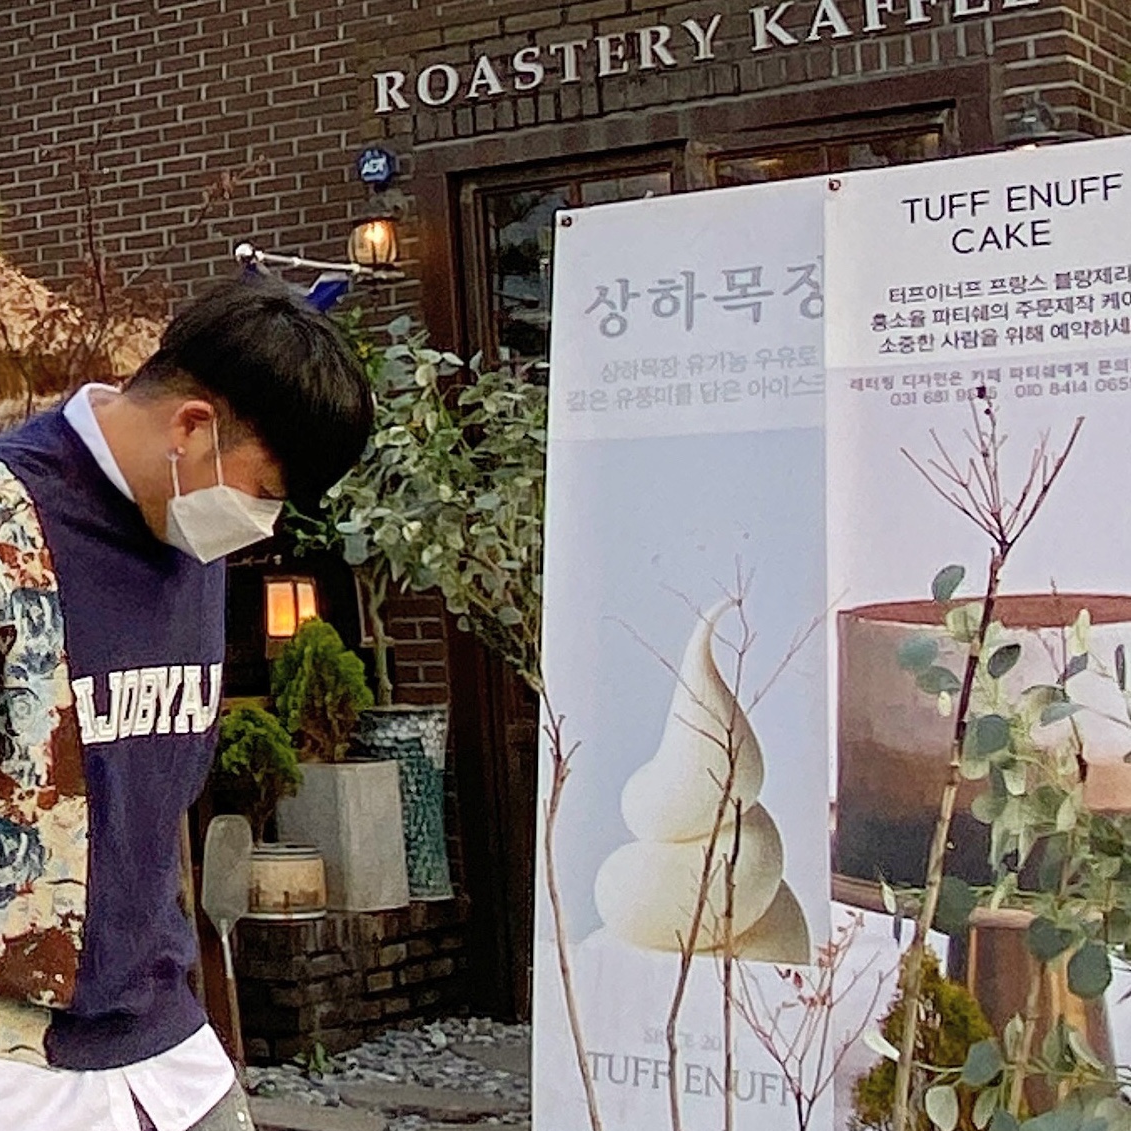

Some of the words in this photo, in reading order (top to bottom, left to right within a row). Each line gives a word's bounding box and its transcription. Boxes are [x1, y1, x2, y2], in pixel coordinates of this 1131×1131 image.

[372, 14, 722, 114] ROASTERY
[749, 0, 1040, 52] KAFF
[902, 189, 991, 225] TUFF
[1006, 173, 1124, 213] ENUFF
[952, 218, 1053, 254] CAKE
[888, 281, 982, 305] 터프이너프
[987, 274, 1049, 297] 프랑스
[1015, 294, 1095, 320] 주문제작
[879, 334, 935, 355] 소중한
[941, 328, 999, 351] 사람을
[1005, 325, 1044, 345] 위해
[685, 351, 748, 374] 유기농
[586, 1051, 669, 1090] TUFF
